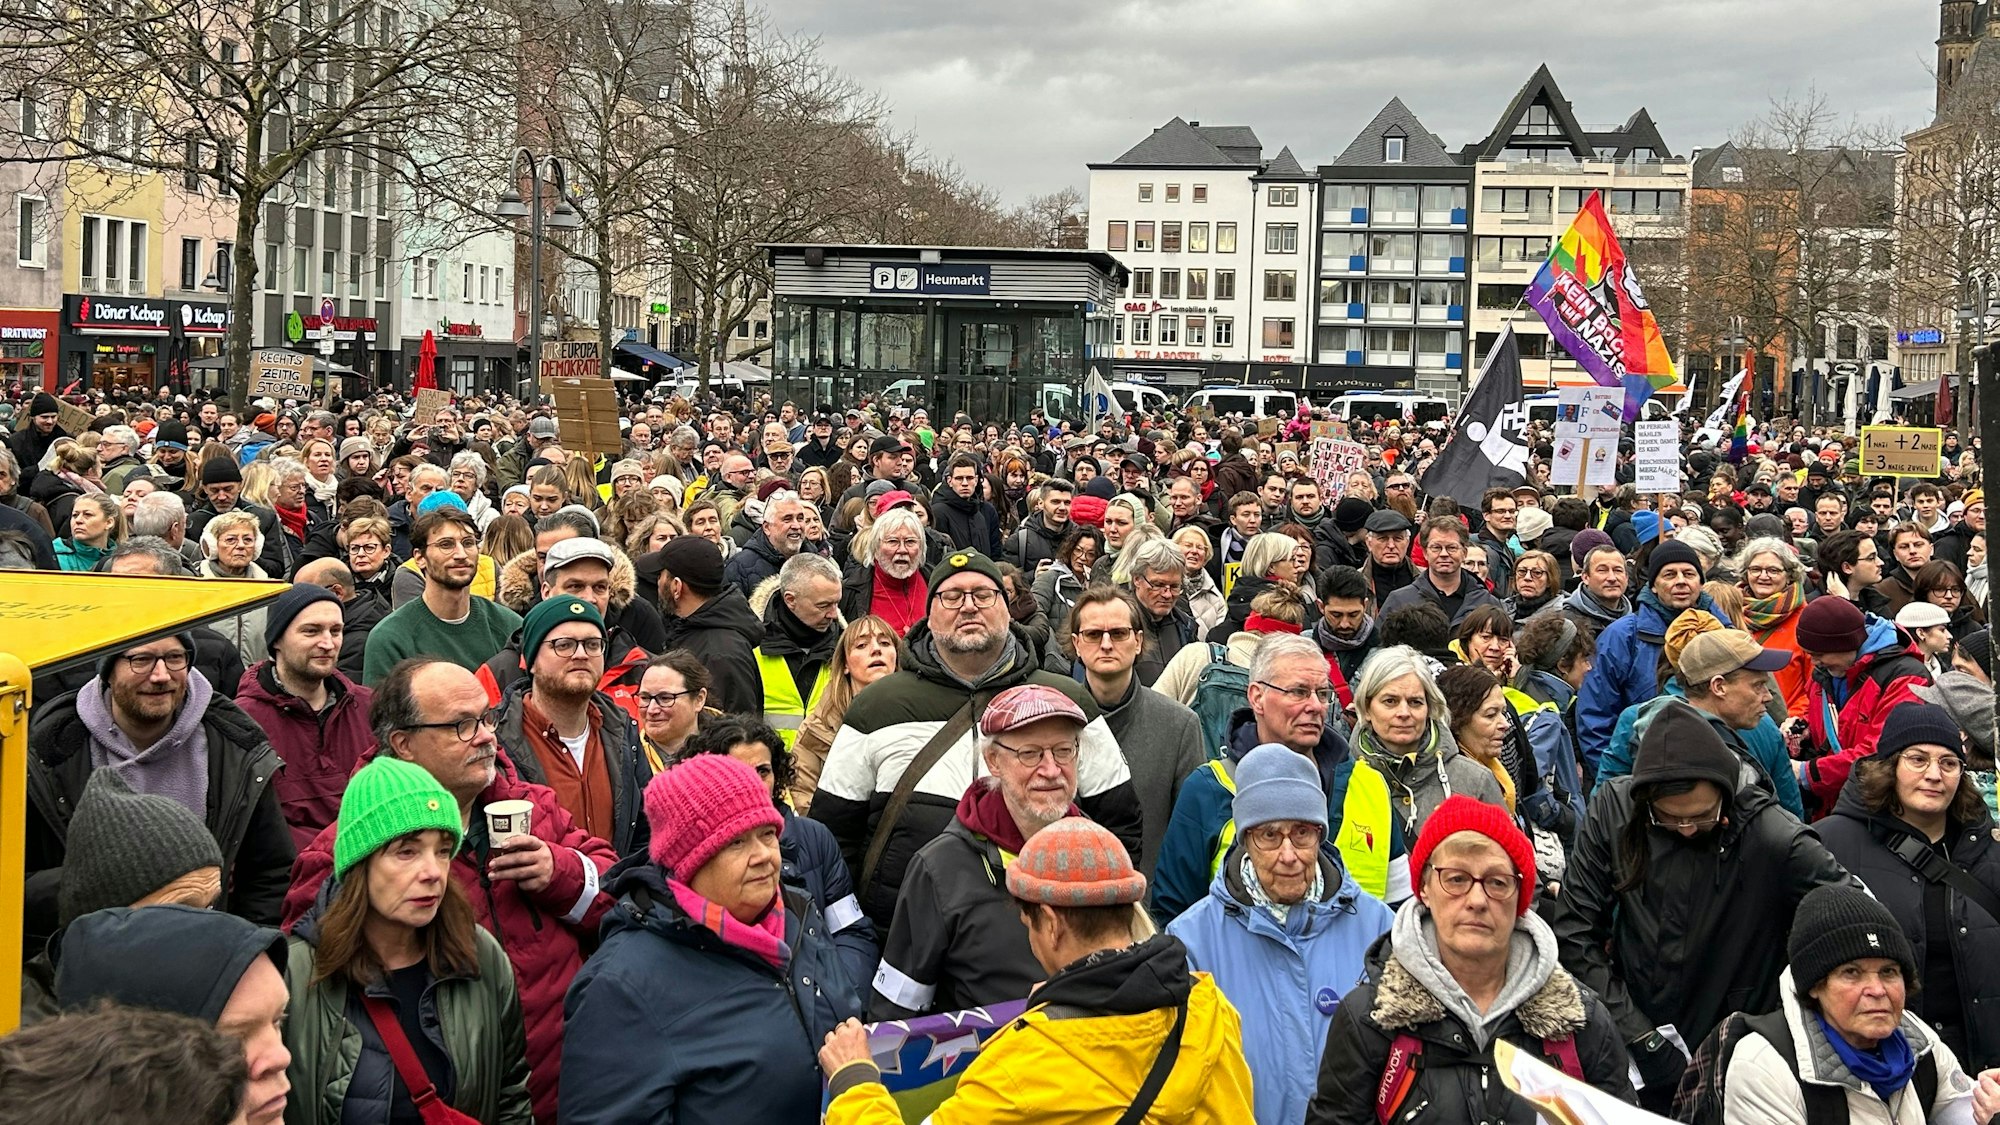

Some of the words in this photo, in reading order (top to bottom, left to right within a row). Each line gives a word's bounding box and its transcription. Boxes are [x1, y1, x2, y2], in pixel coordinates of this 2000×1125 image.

[925, 273, 985, 286] Heumarkt
[95, 303, 129, 320] Döner
[130, 304, 164, 327] Kebap
[1124, 303, 1146, 312] GAG
[195, 307, 225, 329] Kebap
[1557, 274, 1597, 316] KEIN
[1592, 314, 1625, 358] BOC
[1, 327, 47, 339] BRATWURST
[561, 342, 599, 358] EUROPA
[1577, 319, 1627, 378] NAZIS
[259, 351, 303, 366] RECHTS
[1263, 355, 1293, 363] HOTEL
[260, 368, 301, 381] ZEITIG
[541, 359, 602, 376] DEMOKRATIE
[1257, 377, 1293, 385] HOTEL
[1335, 379, 1385, 388] APOSTEL
[256, 381, 309, 397] STOPPEN
[1316, 441, 1332, 451] ICH
[1864, 433, 1872, 448] 1
[1911, 433, 1921, 450] 2
[1313, 450, 1342, 463] SAUER
[1876, 454, 1886, 470] 3
[1312, 460, 1329, 470] HAB
[1379, 1047, 1403, 1105] ORTOVOX
